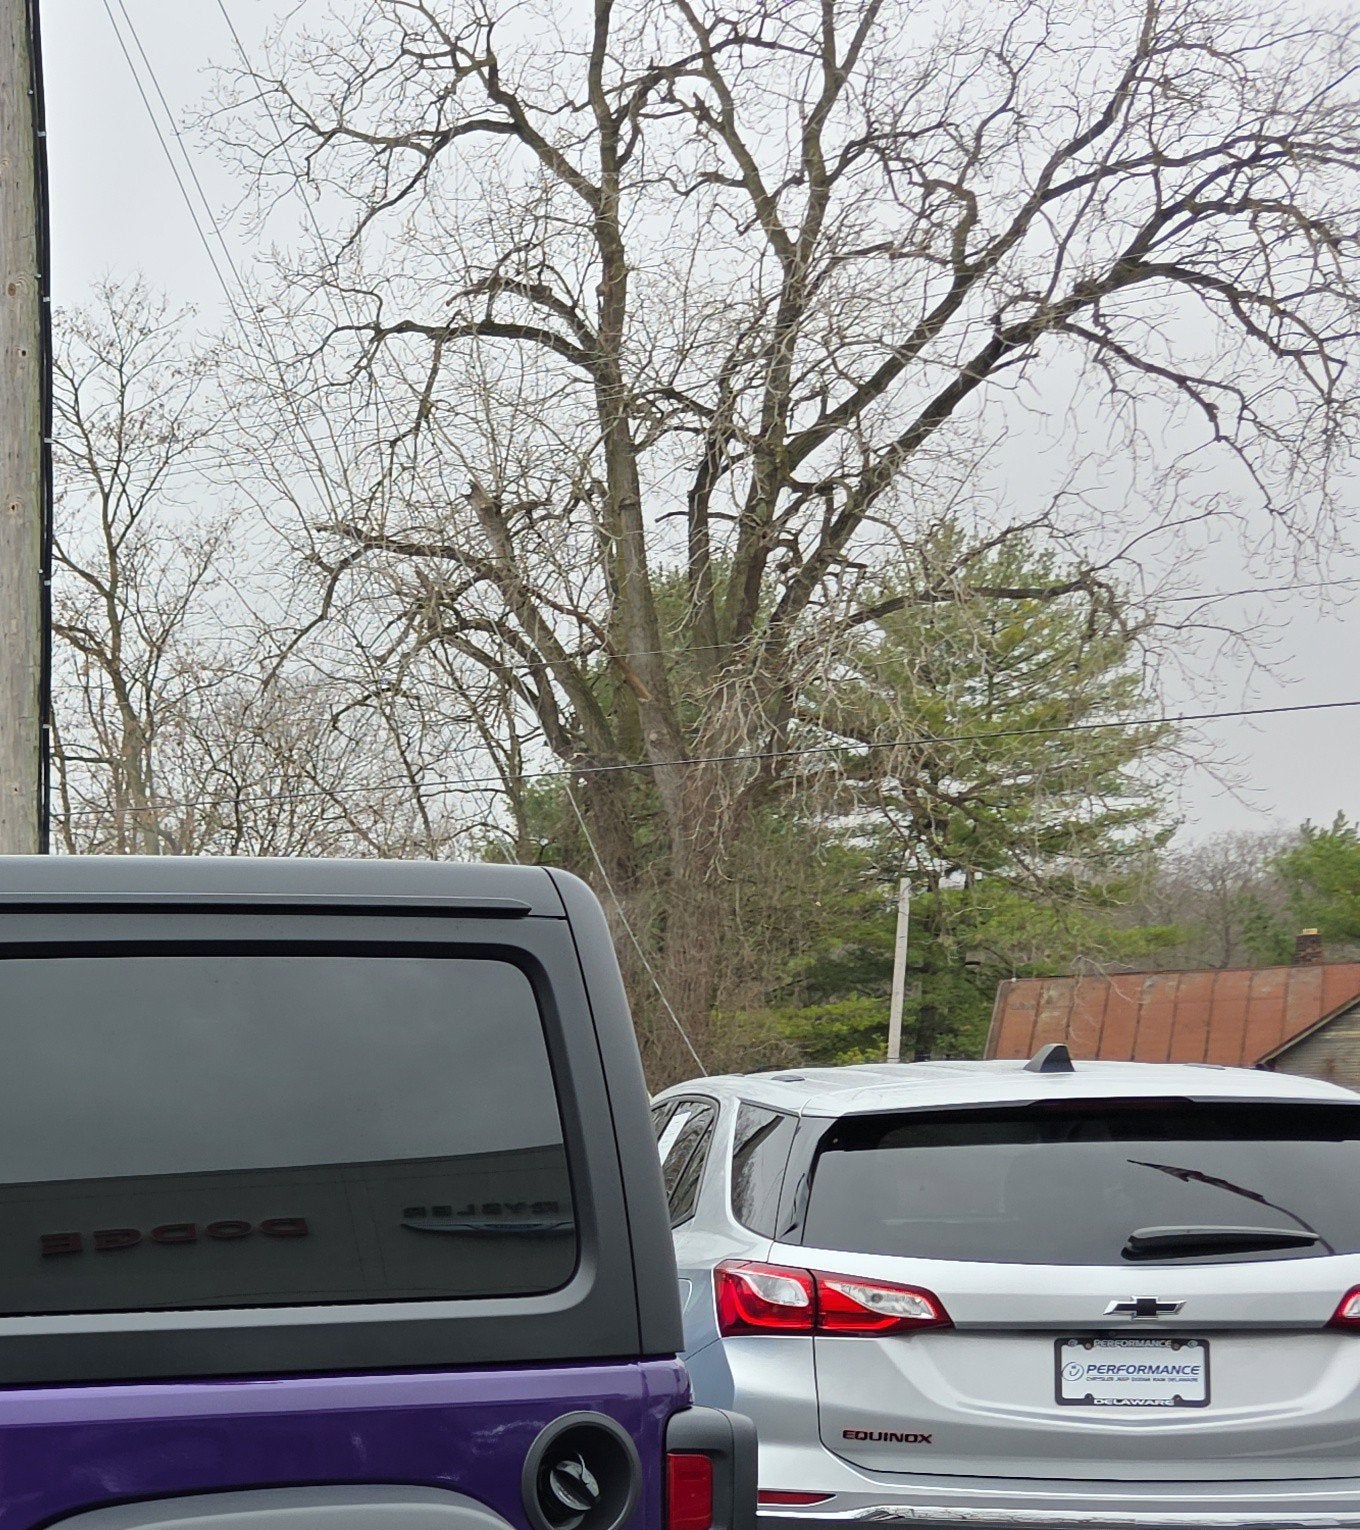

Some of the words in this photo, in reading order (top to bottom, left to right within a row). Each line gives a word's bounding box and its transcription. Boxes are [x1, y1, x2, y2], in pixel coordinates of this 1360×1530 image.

[1093, 1339, 1173, 1348] PERFORMANCE
[1086, 1363, 1201, 1376] PERFORMANCE
[1093, 1398, 1175, 1406] DELAWARE
[842, 1429, 933, 1444] EQUINOX
